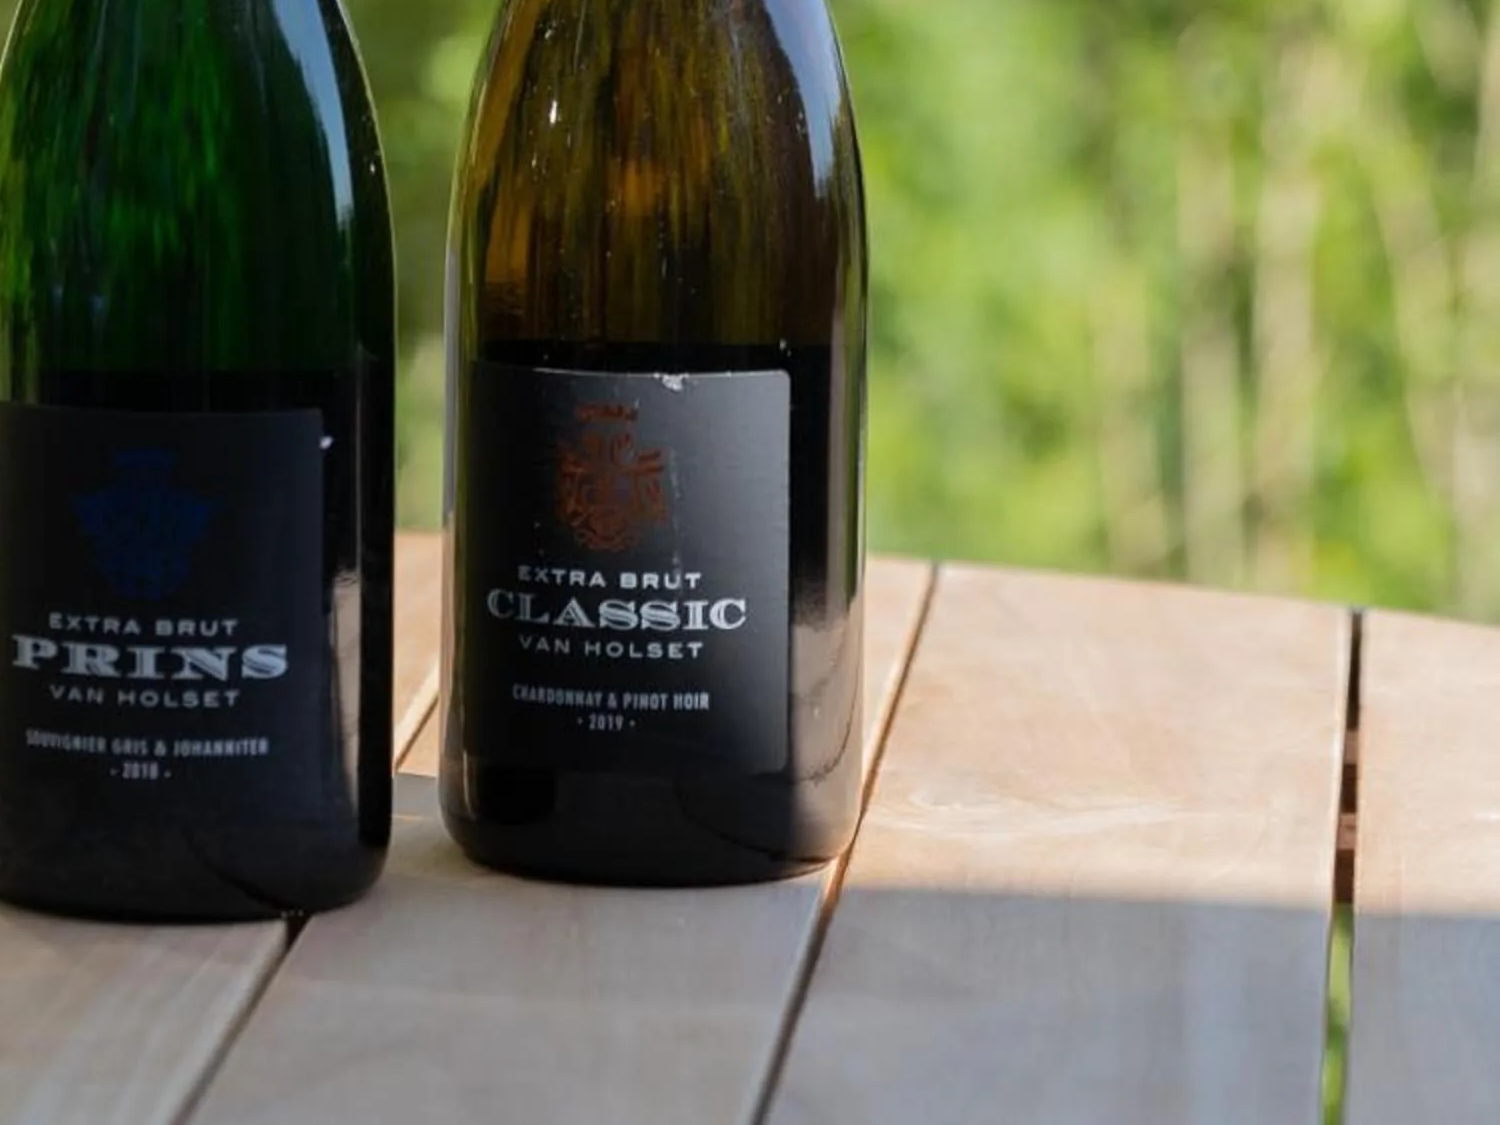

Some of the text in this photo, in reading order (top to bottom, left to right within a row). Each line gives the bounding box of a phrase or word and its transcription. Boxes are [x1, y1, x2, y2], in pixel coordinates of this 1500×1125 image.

[518, 565, 702, 590] EXTRA BRUT
[487, 588, 746, 631] CLASSIC
[49, 612, 239, 637] EXTRA BRUT
[12, 634, 288, 681] PRINS
[519, 634, 704, 659] VAN HOLSET
[49, 684, 240, 708] VAN HOLSET
[512, 683, 710, 710] CHARDONNAY & PINOT NOIR
[25, 728, 269, 758] SOUVIGNIER GRIS & JOHANNITER
